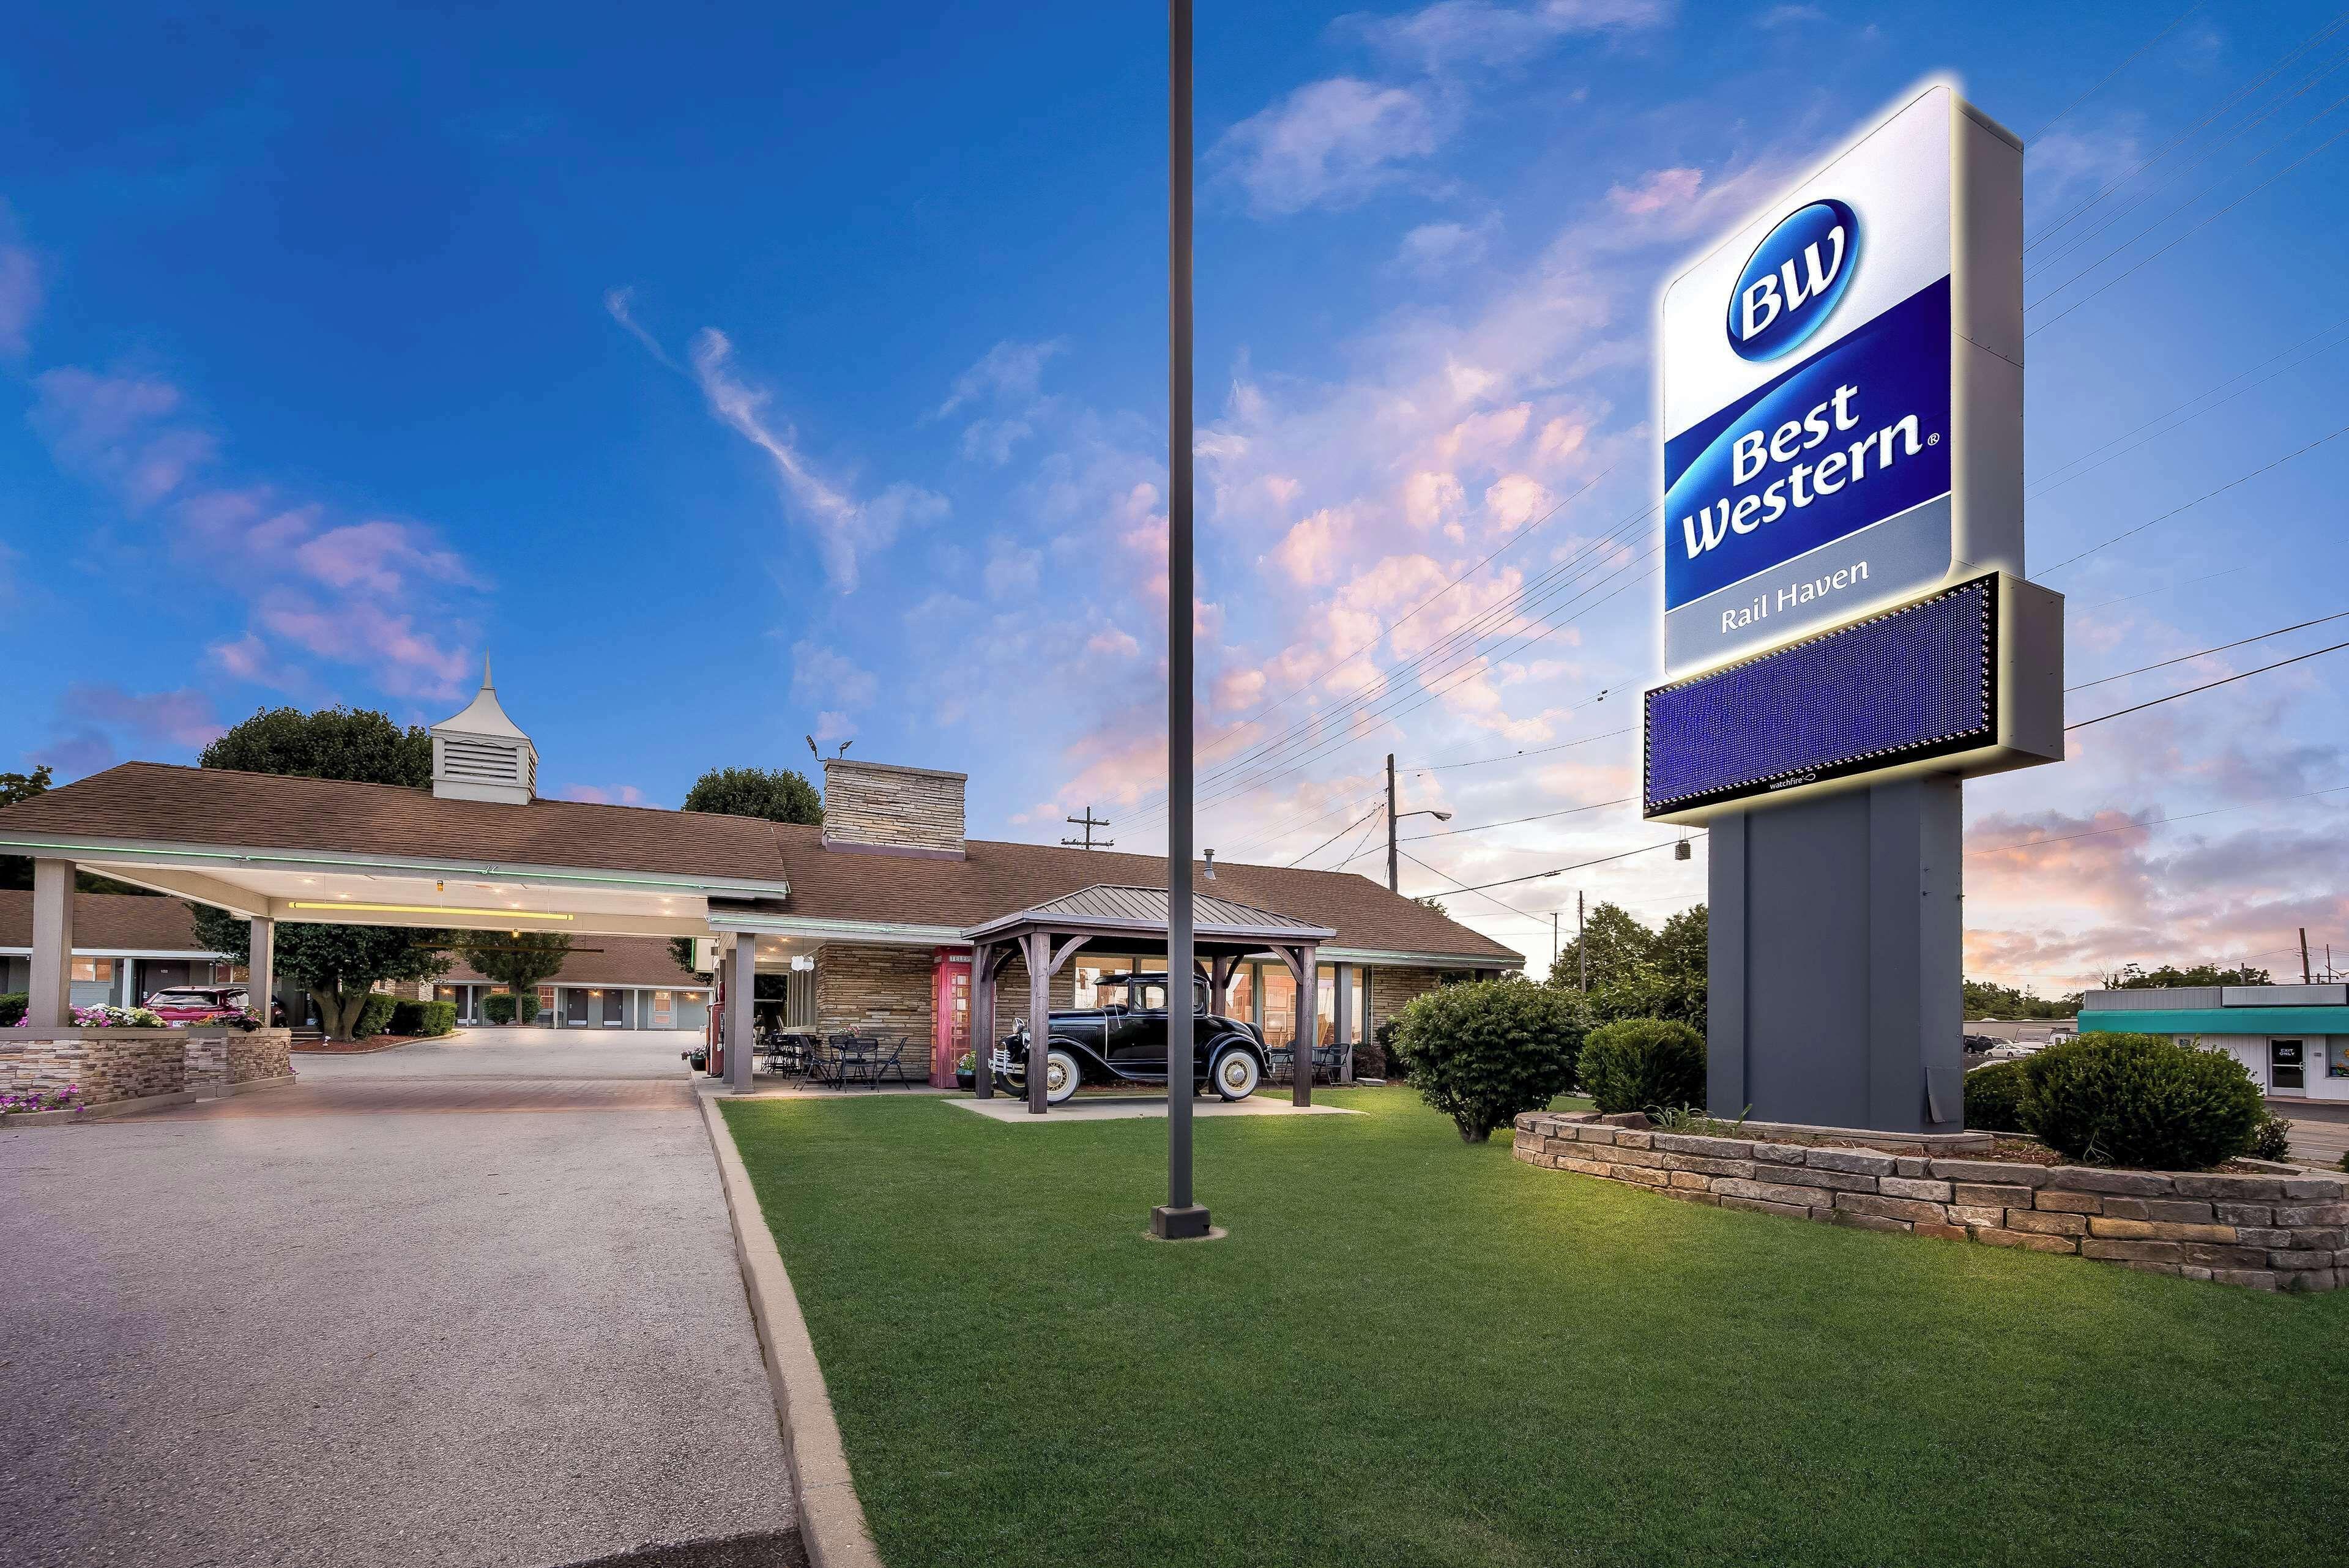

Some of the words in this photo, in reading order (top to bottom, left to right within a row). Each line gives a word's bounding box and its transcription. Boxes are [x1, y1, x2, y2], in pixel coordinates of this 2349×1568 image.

[1742, 225, 1845, 342] BW
[1732, 383, 1859, 487] Best
[1721, 593, 1768, 635] Rail
[1776, 559, 1870, 613] Haven
[1770, 778, 1803, 790] watchfire
